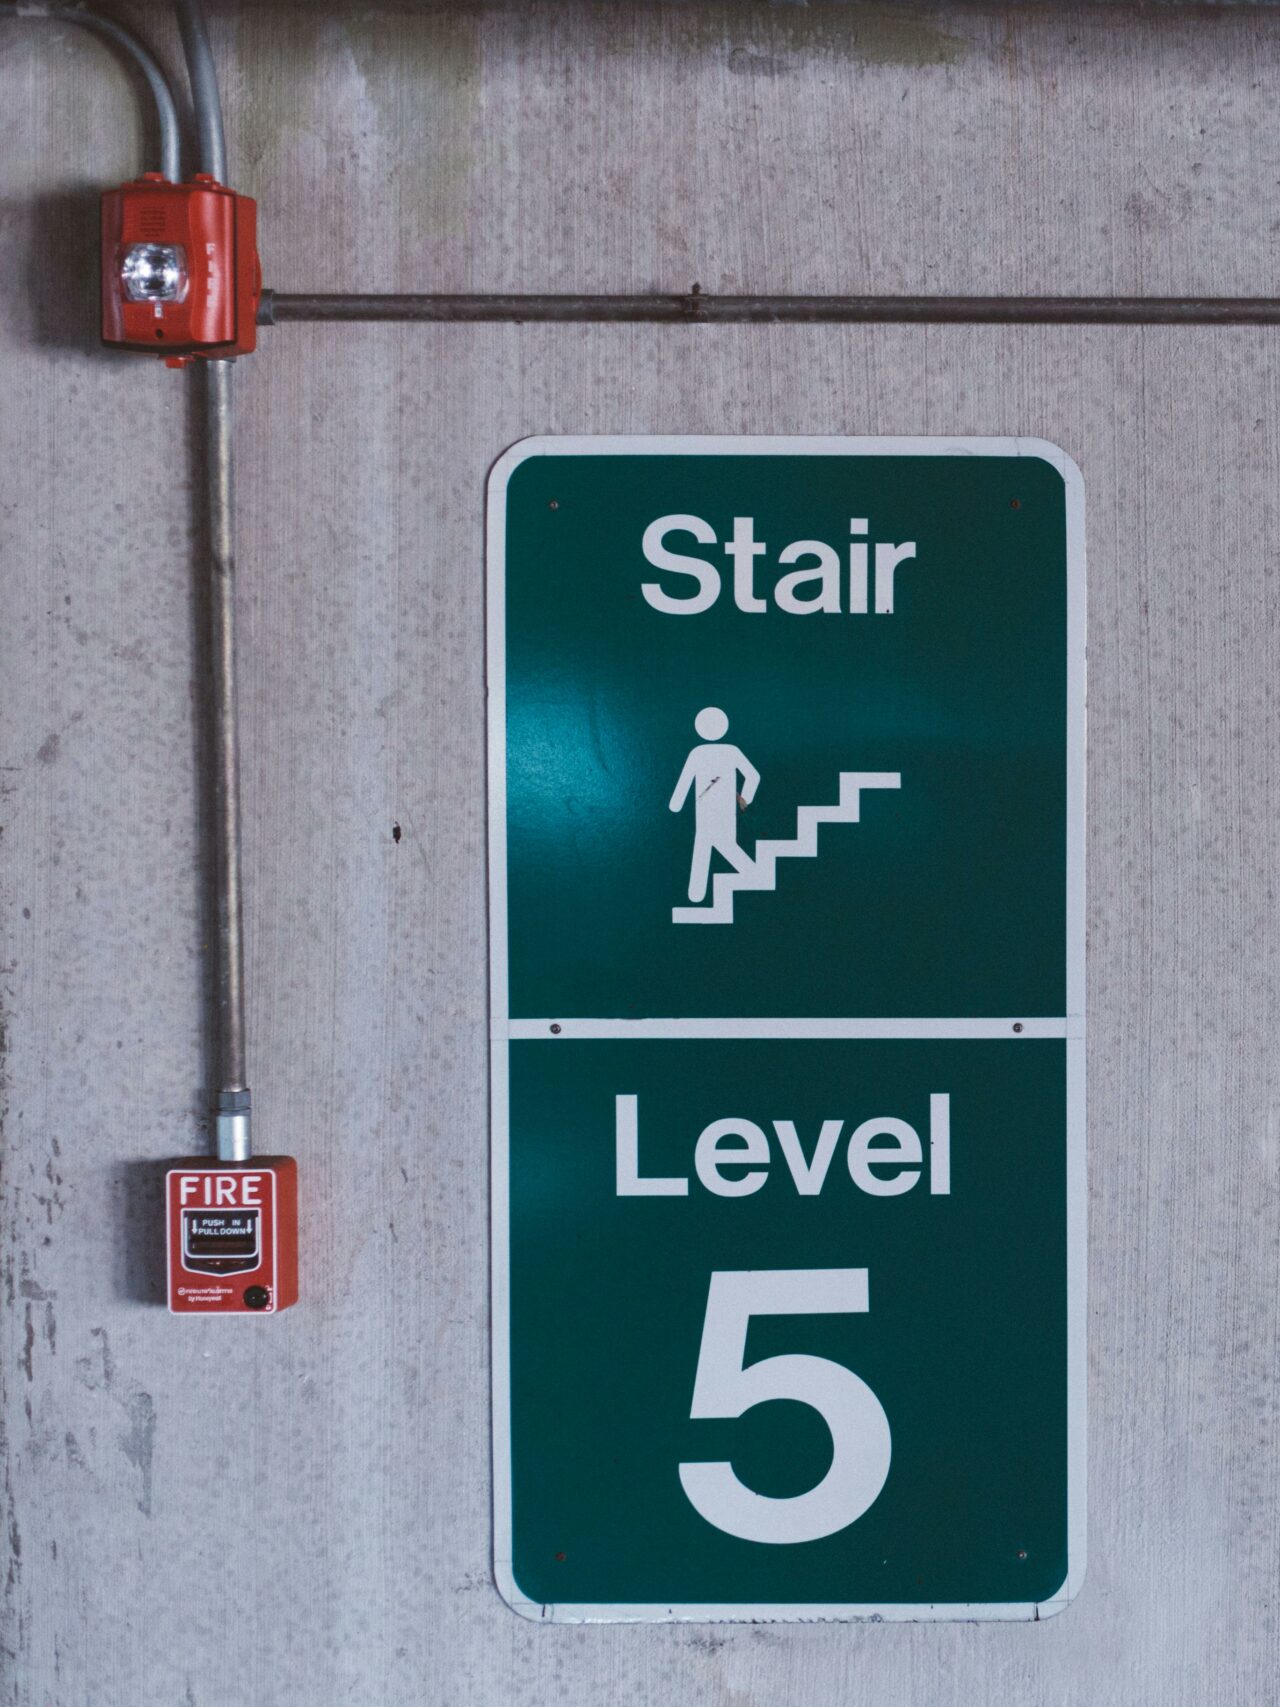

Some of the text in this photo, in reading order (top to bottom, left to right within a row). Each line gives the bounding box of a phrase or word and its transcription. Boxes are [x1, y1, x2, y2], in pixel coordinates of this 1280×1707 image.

[641, 513, 916, 615] Stair
[180, 1176, 263, 1206] FIRE
[615, 1092, 951, 1198] Level
[678, 1267, 892, 1545] 5
